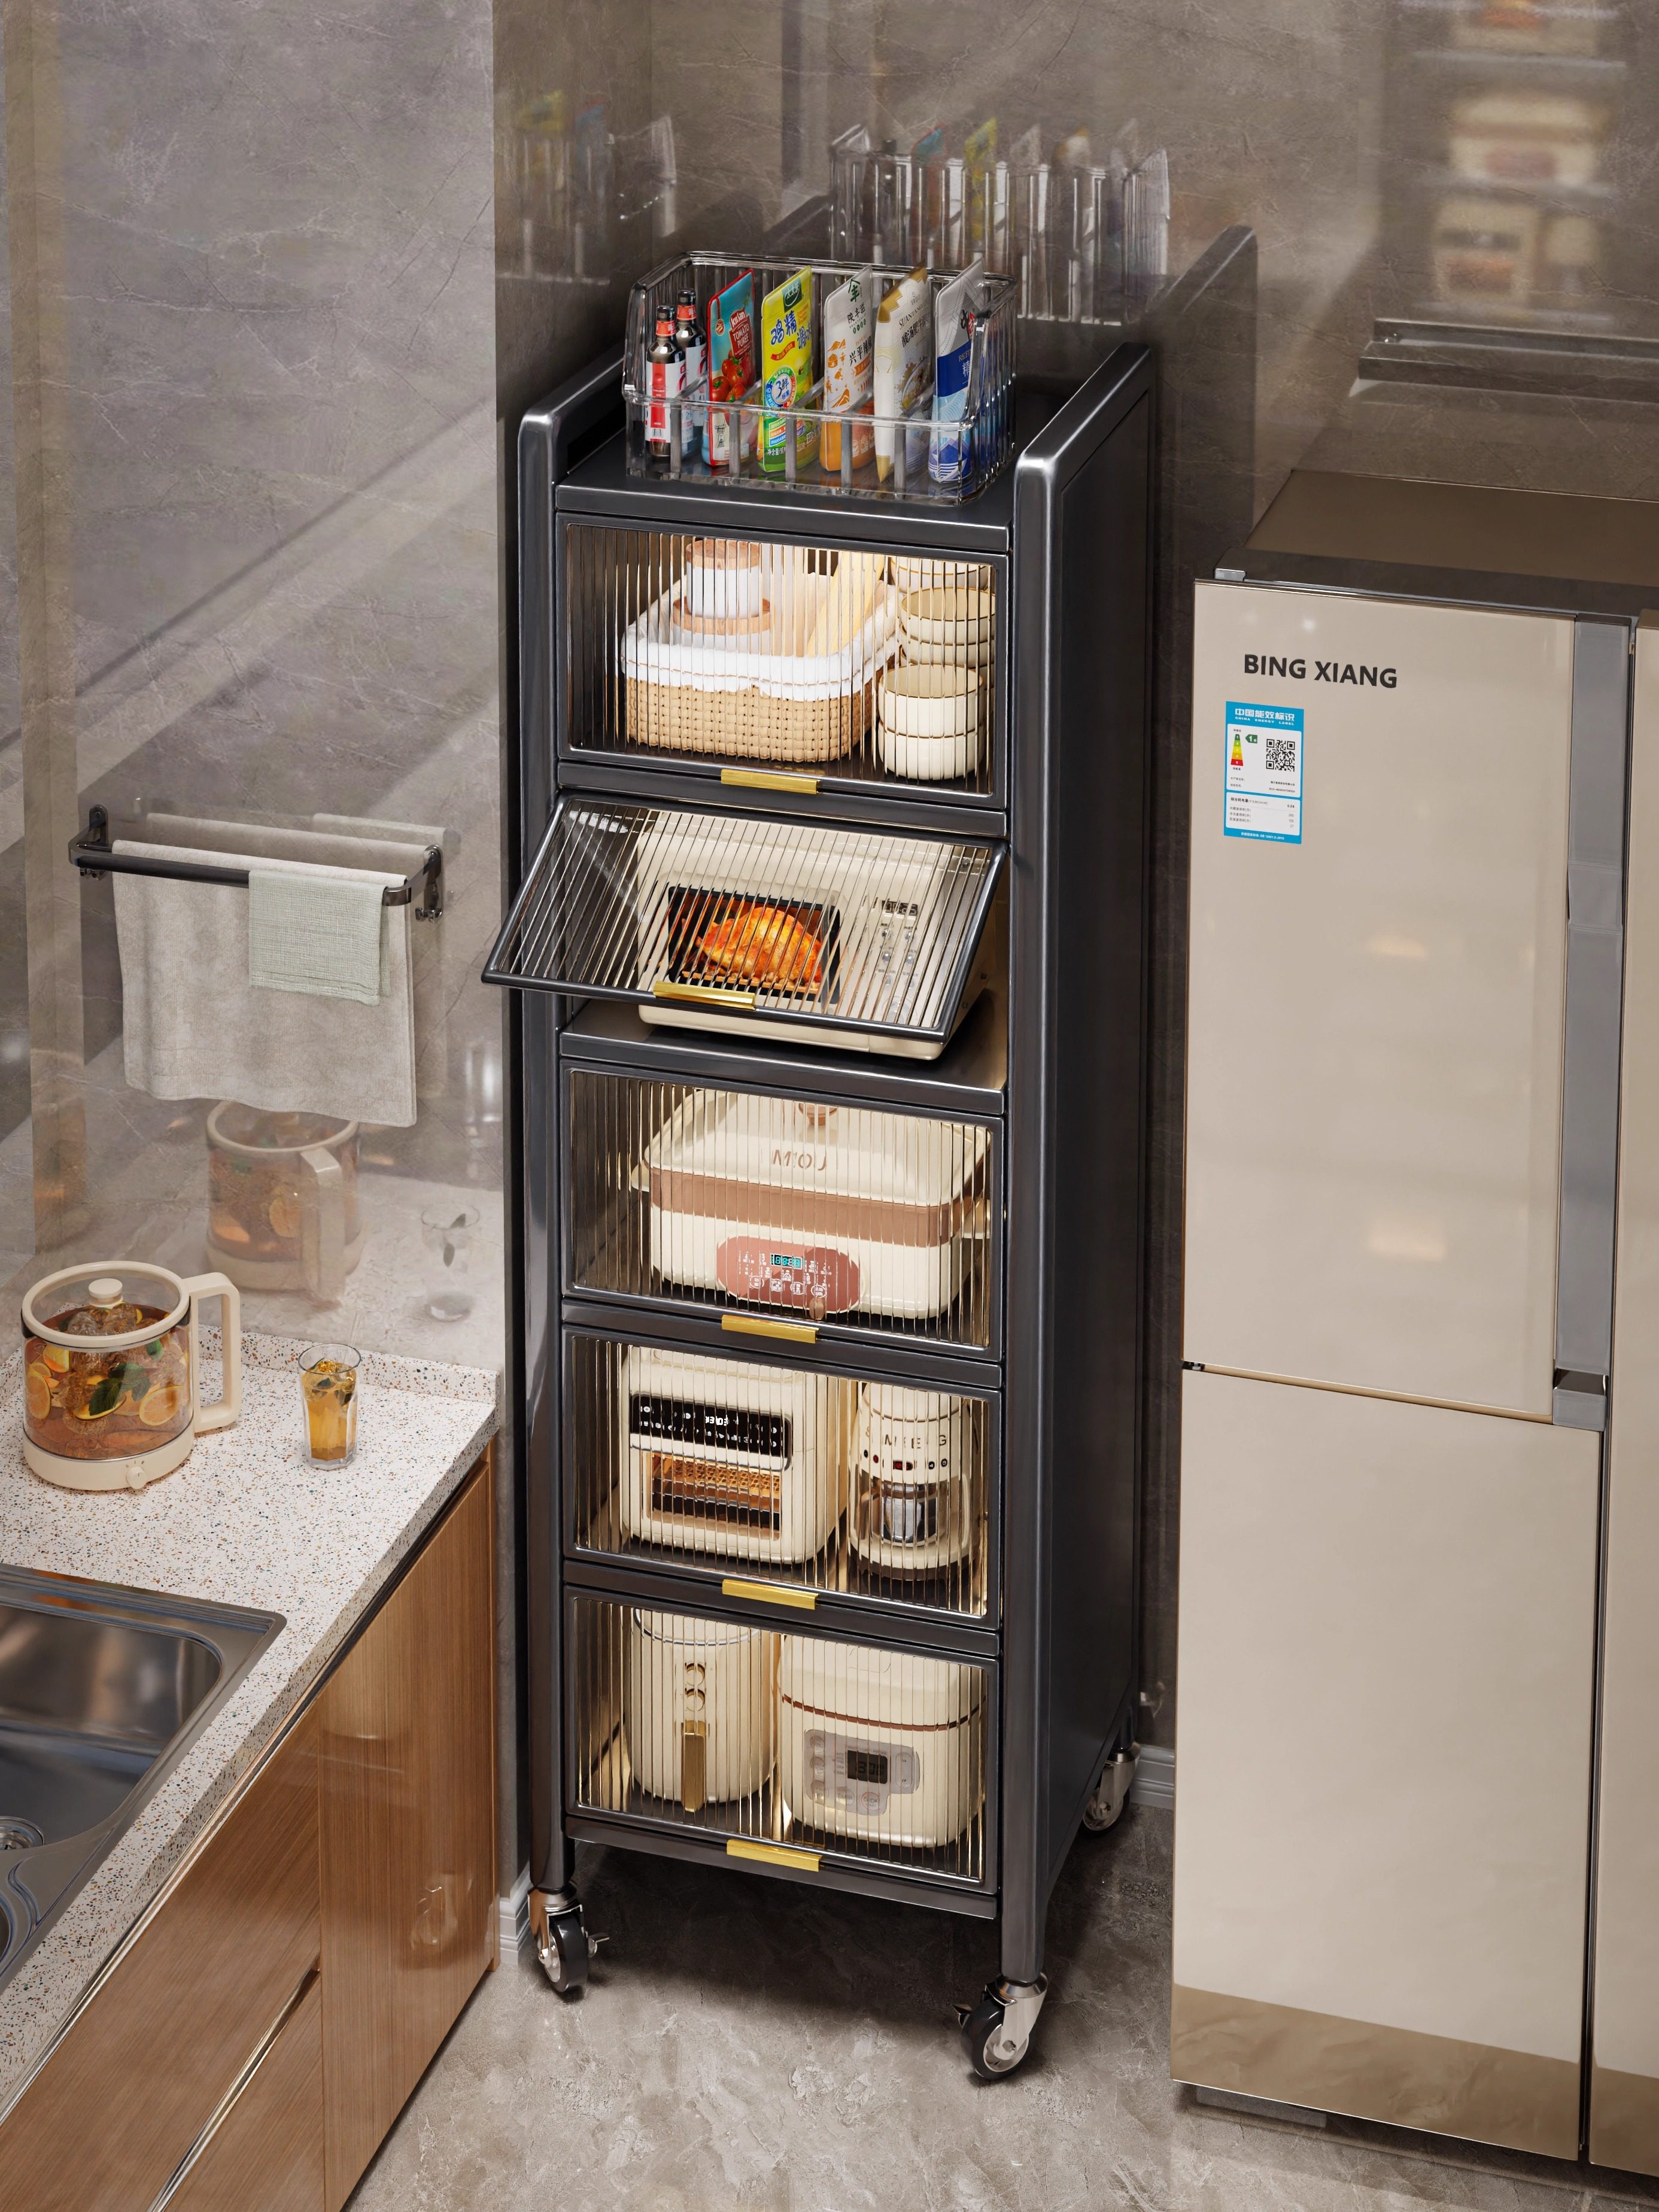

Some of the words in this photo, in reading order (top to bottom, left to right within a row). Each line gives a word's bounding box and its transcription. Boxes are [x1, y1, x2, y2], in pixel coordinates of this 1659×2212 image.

[733, 323, 749, 342] TOMATO
[771, 311, 797, 345] 鸡精
[737, 333, 749, 348] PUREE
[1244, 654, 1306, 679] BING
[1314, 661, 1397, 688] XIANG
[1235, 708, 1295, 721] 中国能效标识
